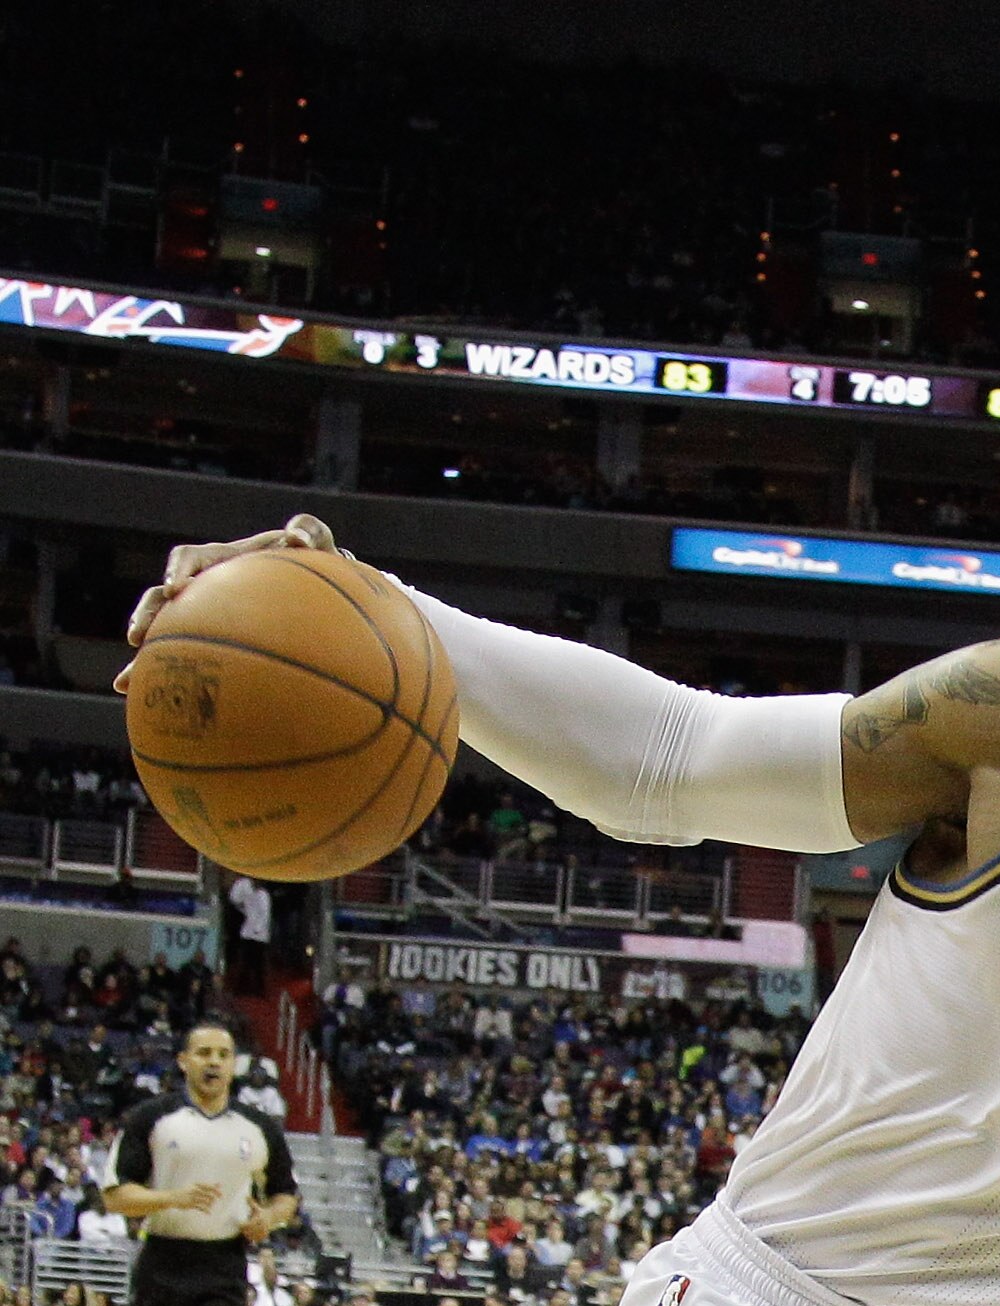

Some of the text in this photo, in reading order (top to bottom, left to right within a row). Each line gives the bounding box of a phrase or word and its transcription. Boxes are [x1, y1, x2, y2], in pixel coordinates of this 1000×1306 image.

[416, 346, 438, 369] 3
[465, 343, 636, 385] WIZARDS
[661, 361, 712, 393] 83
[791, 378, 815, 401] 4
[849, 372, 932, 407] 7:05
[164, 926, 209, 950] 107
